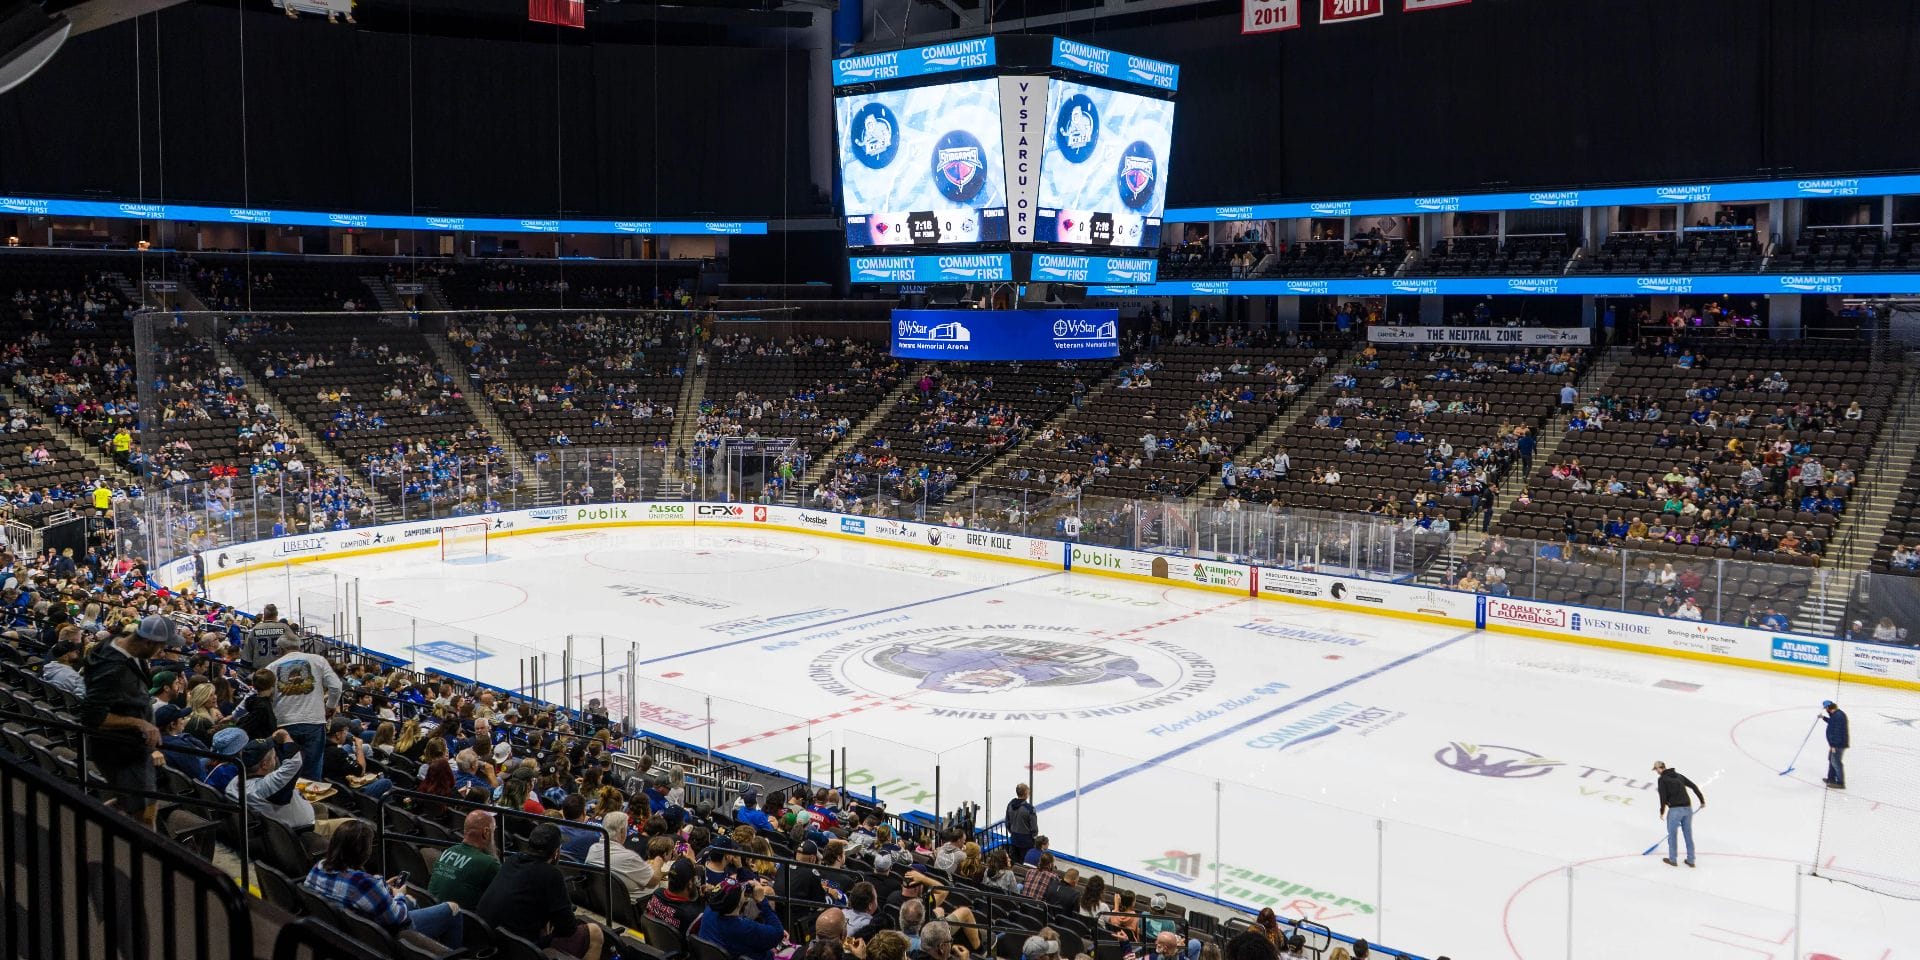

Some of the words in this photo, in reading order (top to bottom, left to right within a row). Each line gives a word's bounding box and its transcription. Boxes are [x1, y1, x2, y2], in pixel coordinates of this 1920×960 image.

[1334, 0, 1369, 15] 2011
[1255, 6, 1286, 26] 2011
[922, 40, 987, 58] COMMUNITY
[1059, 41, 1110, 62] COMMUNITY
[839, 54, 898, 72] COMMUNITY
[960, 53, 987, 67] FIRST
[1088, 58, 1109, 74] FIRST
[1128, 56, 1174, 76] COMMUNITY
[874, 66, 898, 78] FIRST
[1154, 72, 1173, 87] FIRST
[1656, 185, 1711, 196] COMMUNITY
[1798, 179, 1859, 190] COMMUNITY
[1833, 186, 1859, 195] FIRST
[1415, 198, 1459, 207] COMMUNITY
[1529, 192, 1579, 201] COMMUNITY
[1558, 198, 1579, 206] FIRST
[1689, 193, 1711, 201] FIRST
[0, 199, 48, 207] COMMUNITY
[120, 204, 165, 212] COMMUNITY
[1311, 202, 1351, 210] COMMUNITY
[1441, 203, 1459, 211] FIRST
[28, 206, 48, 214] FIRST
[147, 211, 165, 219] FIRST
[230, 209, 271, 217] COMMUNITY
[1215, 207, 1253, 215] COMMUNITY
[1334, 208, 1351, 216] FIRST
[946, 222, 951, 231] 0
[856, 257, 915, 270] COMMUNITY
[938, 255, 1003, 269] COMMUNITY
[1038, 256, 1090, 269] COMMUNITY
[1107, 258, 1152, 271] COMMUNITY
[891, 269, 915, 281] FIRST
[977, 267, 1004, 280] FIRST
[1068, 268, 1090, 281] FIRST
[1133, 270, 1152, 282] FIRST
[1508, 279, 1558, 287] COMMUNITY
[1637, 278, 1693, 286] COMMUNITY
[1780, 276, 1842, 286] COMMUNITY
[1419, 286, 1437, 294] FIRST
[1537, 285, 1558, 293] FIRST
[1669, 285, 1692, 293] FIRST
[1815, 284, 1842, 293] FIRST
[904, 320, 927, 336] VyStar
[1067, 320, 1096, 336] VyStar
[1427, 329, 1444, 341] THE
[1449, 329, 1491, 341] NEUTRAL
[1497, 329, 1522, 341] ZONE
[917, 342, 945, 350] Memorial
[529, 508, 567, 517] COMMUNITY
[578, 507, 627, 520] Publix
[649, 504, 684, 513] ALSCO
[698, 505, 733, 515] CFX
[404, 528, 431, 537] CAMPIONE
[1067, 524, 1076, 532] 18
[283, 537, 322, 553] LIBERTY
[341, 538, 370, 549] CAMPIONE
[383, 535, 396, 544] LAW
[967, 533, 988, 546] GREY
[991, 536, 1012, 550] KOLE
[1072, 548, 1121, 569] Publix
[1205, 565, 1243, 577] campers
[1211, 576, 1226, 585] inn
[1227, 576, 1241, 586] RV
[1501, 602, 1552, 616] DARLEY'S
[1498, 609, 1556, 623] PLUMBING
[724, 608, 849, 637] COMMUNITY
[1584, 617, 1612, 630] WEST
[1614, 621, 1651, 635] SHORE
[855, 625, 960, 644] CAMPIONE
[1667, 629, 1689, 637] Boring
[1781, 642, 1820, 654] ATLANTIC
[812, 654, 839, 663] TO
[1773, 648, 1796, 660] SELF
[1797, 650, 1830, 665] STORAGE
[1872, 655, 1889, 663] every
[809, 663, 856, 696] WELCOME
[926, 707, 998, 720] RINK
[1004, 710, 1069, 721] LAW
[1146, 706, 1225, 737] Florida
[1217, 694, 1260, 712] Blue
[1337, 706, 1392, 728] FIRST
[1245, 701, 1361, 750] COMMUNITY
[774, 753, 936, 804] Publix
[1579, 765, 1658, 791] Tru
[1579, 786, 1634, 806] Vet
[439, 849, 472, 869] VFW
[1207, 863, 1378, 914] campers
[1209, 879, 1279, 906] inn
[1281, 899, 1355, 920] RV
